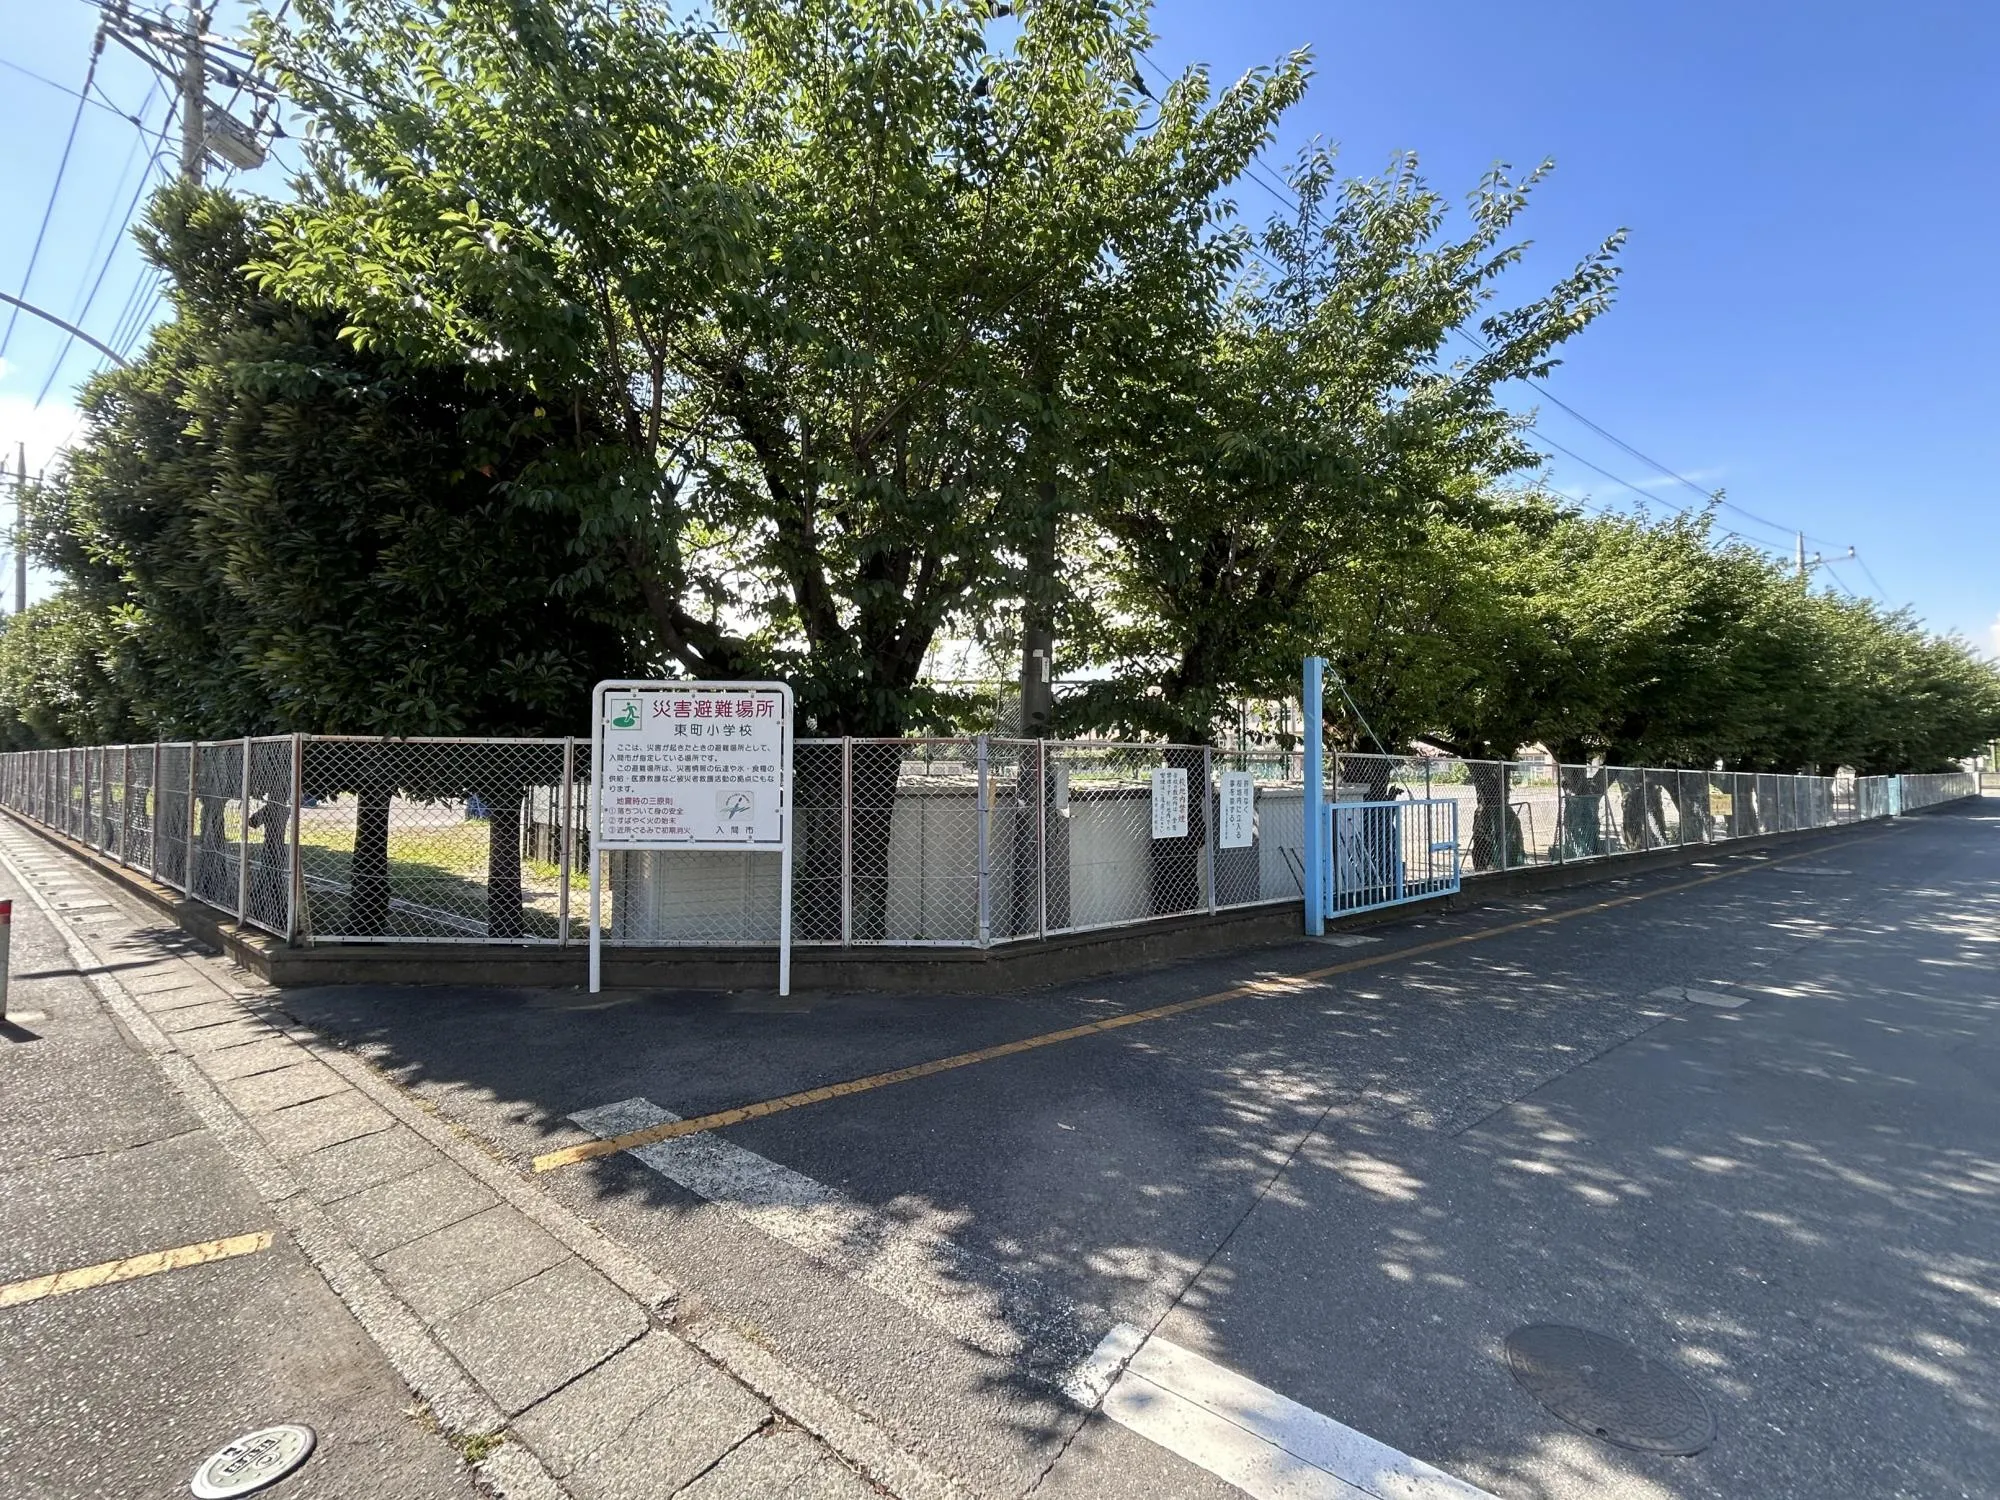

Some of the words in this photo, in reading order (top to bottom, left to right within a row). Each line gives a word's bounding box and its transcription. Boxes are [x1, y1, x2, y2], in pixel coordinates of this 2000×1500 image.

[652, 699, 775, 719] 災害避難場所
[673, 723, 753, 737] 東町小学校
[608, 785, 635, 793] ります。
[616, 797, 673, 806] 地震時の三原則
